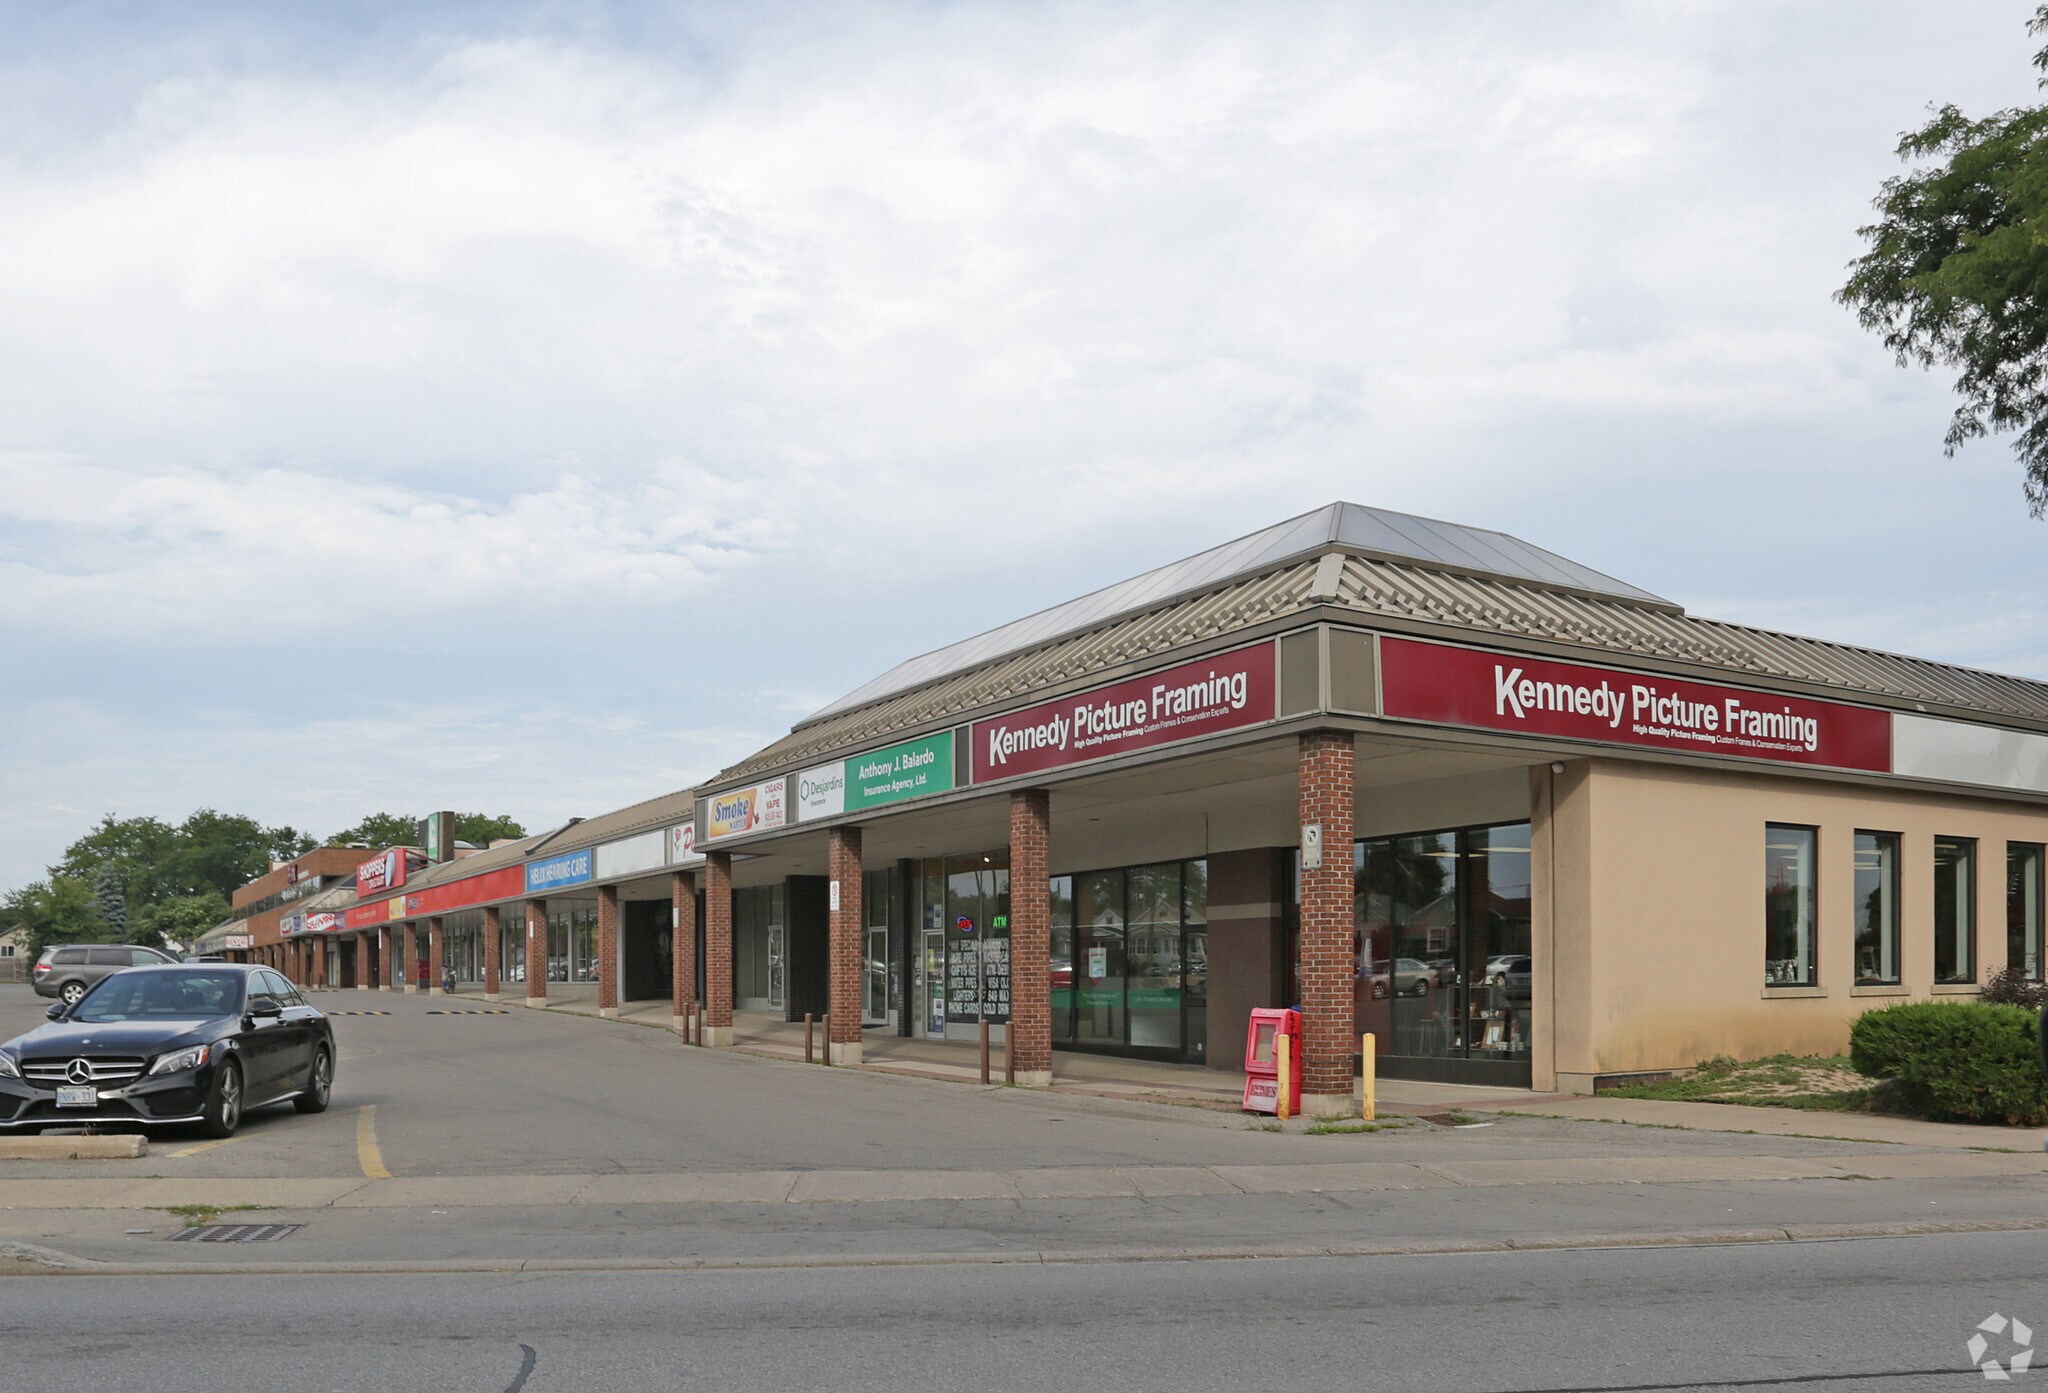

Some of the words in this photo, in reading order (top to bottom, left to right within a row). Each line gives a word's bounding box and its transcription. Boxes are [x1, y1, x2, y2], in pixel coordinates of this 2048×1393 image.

[990, 714, 1070, 766] Kennedy
[1074, 699, 1147, 738] Picture
[1152, 671, 1247, 719] Framing
[1494, 665, 1626, 728] Kennedy
[1632, 685, 1719, 730] Picture
[1725, 699, 1817, 751] Framing
[1074, 740, 1085, 749] High
[1085, 736, 1103, 746] Quality
[1103, 732, 1122, 742] Picture
[1122, 728, 1144, 738] Framing
[1144, 723, 1160, 733] Custom
[1160, 719, 1177, 728] Frames
[1181, 712, 1211, 724] Conservation
[1210, 707, 1229, 717] Experts
[1632, 724, 1648, 735] High
[1648, 726, 1670, 738] Quality
[1670, 728, 1691, 739] Picture
[1691, 731, 1716, 743] Framing
[1716, 735, 1735, 744] Custom
[1735, 737, 1751, 747] Frames
[1756, 740, 1786, 750] Conservation
[1786, 743, 1803, 752] Experts
[859, 762, 893, 780] Anthony
[894, 756, 901, 772] J.
[902, 748, 935, 769] Balardo
[764, 782, 783, 794] CIGARS
[811, 778, 843, 796] Desjardins
[864, 784, 891, 796] Insurance
[891, 778, 915, 793] Agency,
[915, 772, 928, 785] Ltd.
[714, 796, 749, 822] Smoke
[766, 799, 780, 810] VAPE
[360, 858, 385, 880] SHOPPERS
[530, 864, 546, 885] HELIX
[546, 859, 570, 882] HEARING
[570, 856, 587, 878] CARE
[993, 915, 1007, 928] ATM
[950, 965, 968, 976] GIFTS
[953, 990, 976, 1001] LIGHTERS
[948, 1002, 963, 1014] PHONE
[963, 1002, 979, 1014] CARDS
[983, 1003, 997, 1014] COLD
